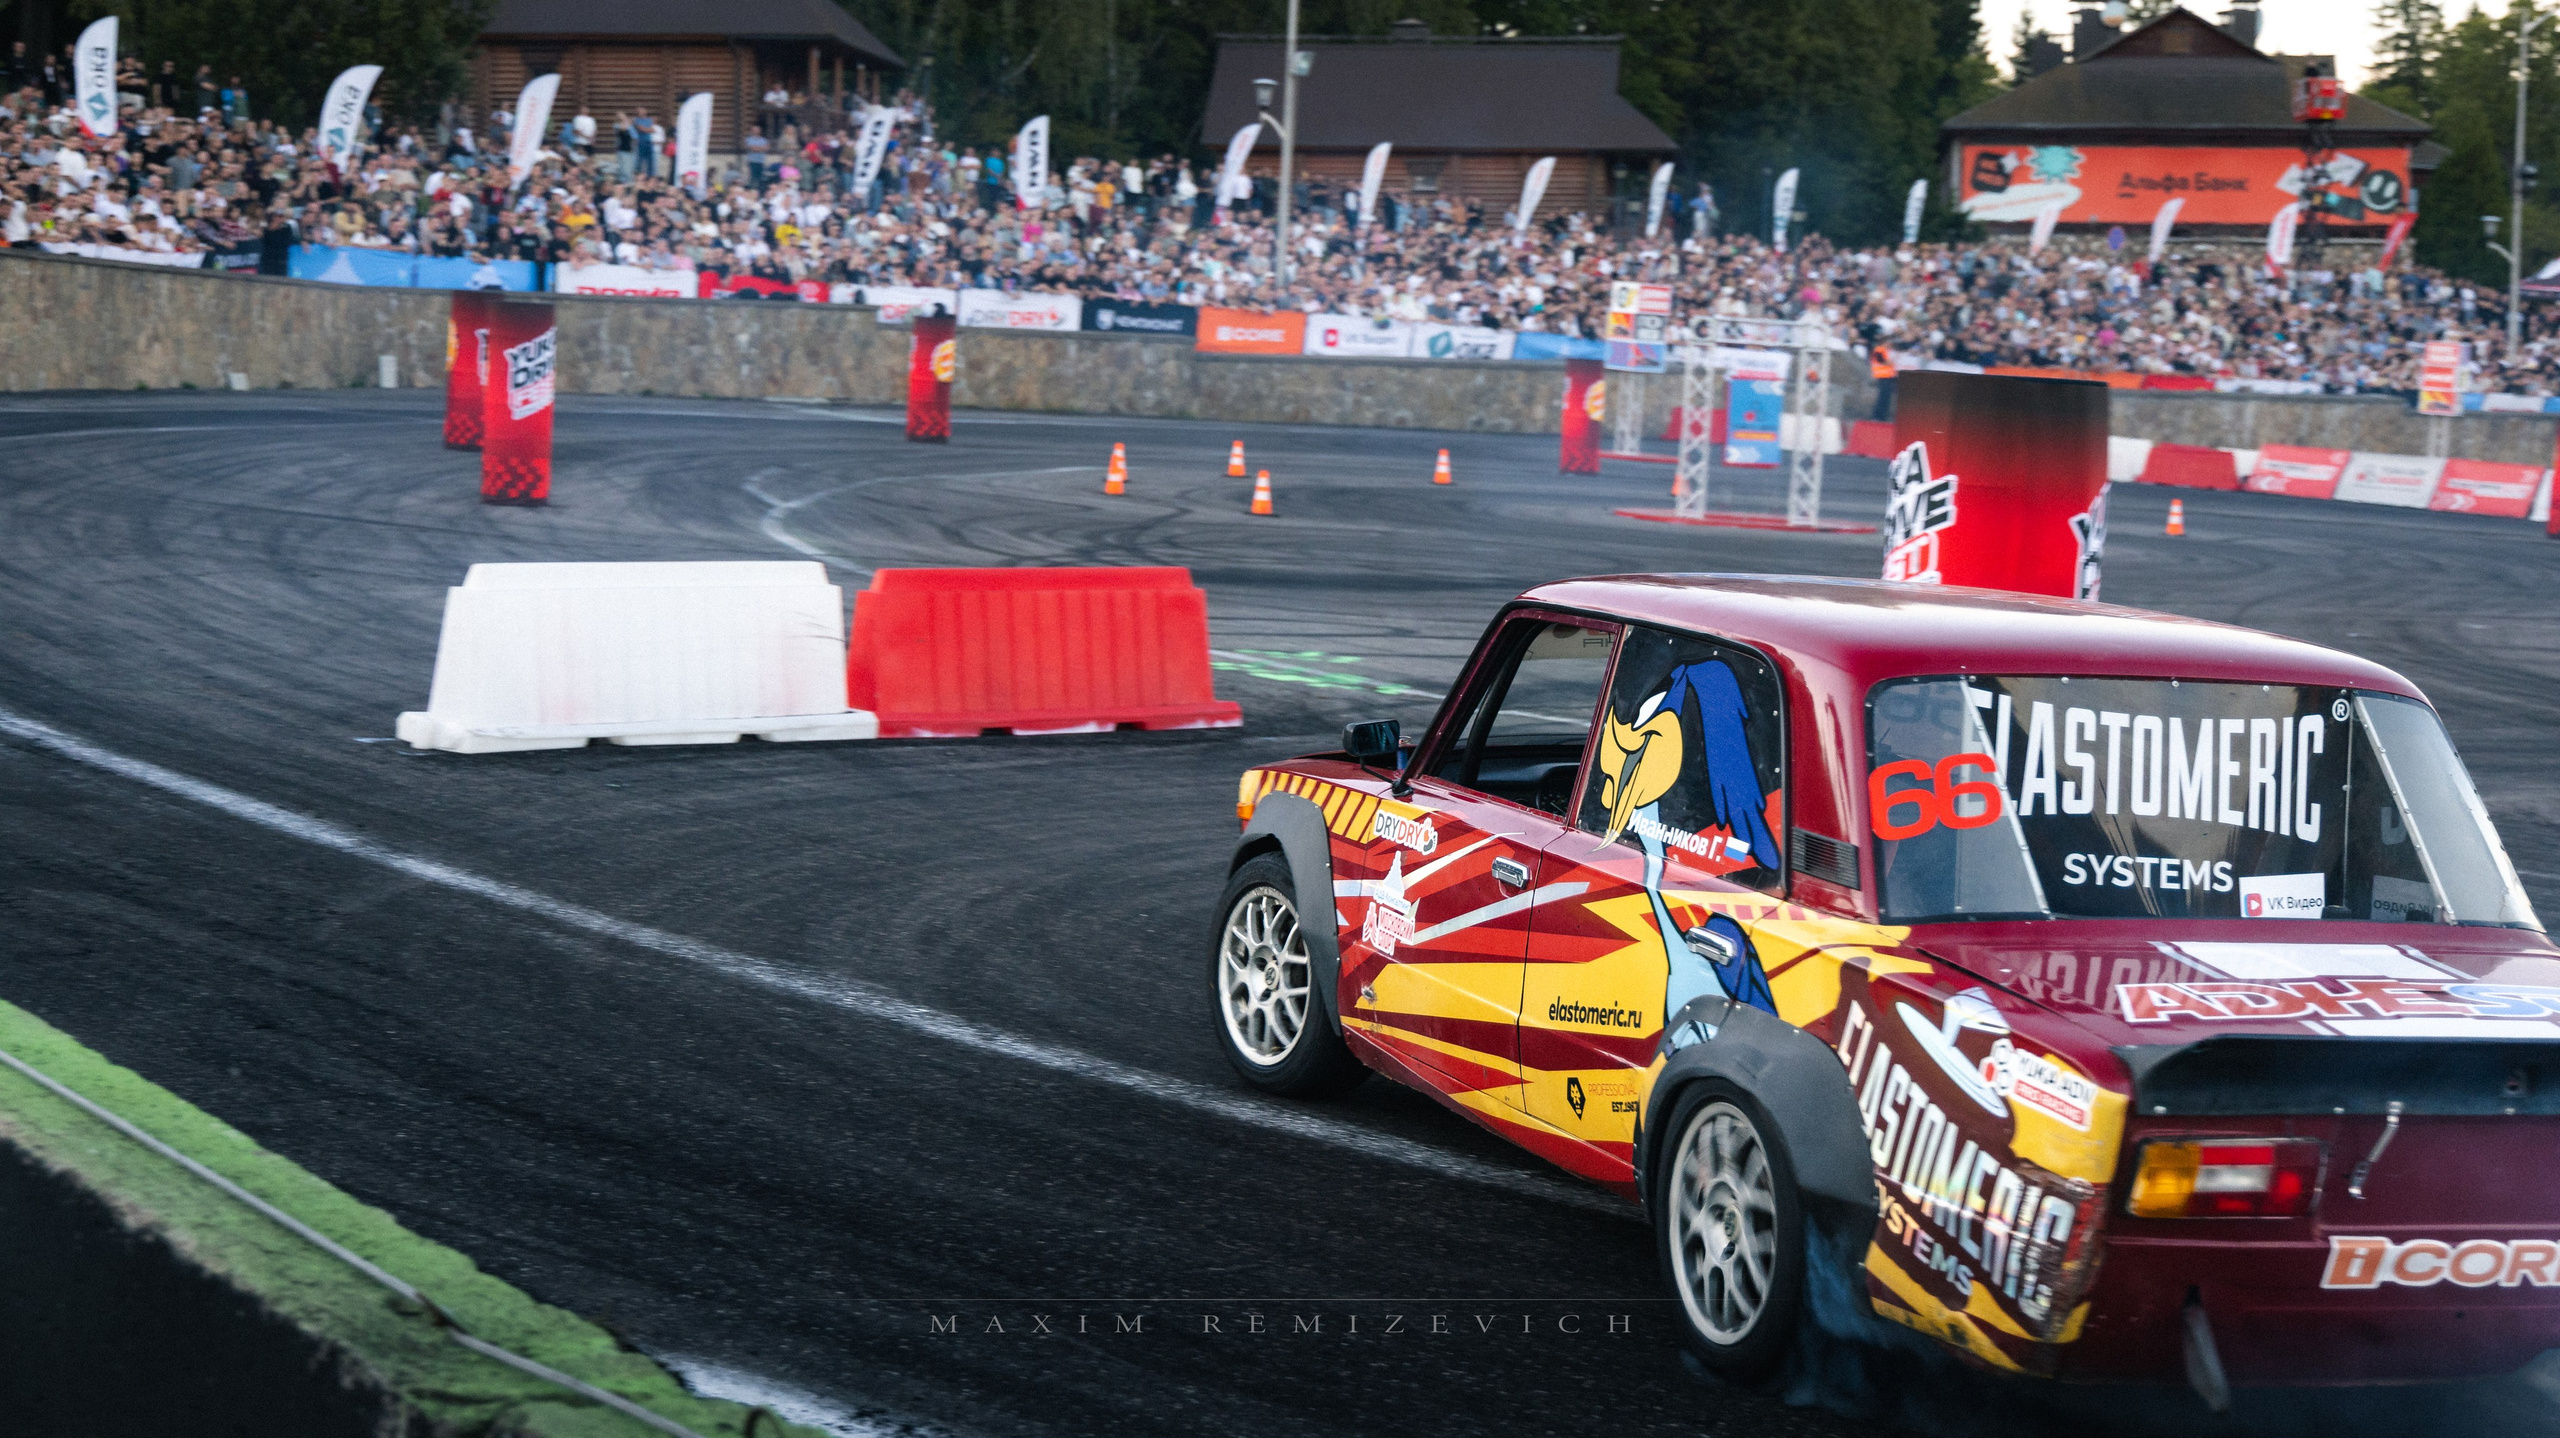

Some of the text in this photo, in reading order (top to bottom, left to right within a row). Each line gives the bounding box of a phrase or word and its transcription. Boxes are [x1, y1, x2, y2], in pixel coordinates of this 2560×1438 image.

[1958, 686, 2324, 843] ELASTOMERIC
[1868, 752, 2003, 841] 66
[1376, 814, 1421, 850] DRYDRY
[1626, 808, 1709, 857] Иванников
[2063, 853, 2233, 892] SYSTEMS
[2267, 895, 2323, 912] VK Видео
[1549, 996, 1642, 1028] elastomeric.ru
[2115, 978, 2560, 1023] ADHES
[1874, 1179, 1974, 1296] YSTEMS
[2328, 1239, 2560, 1285] iCOR
